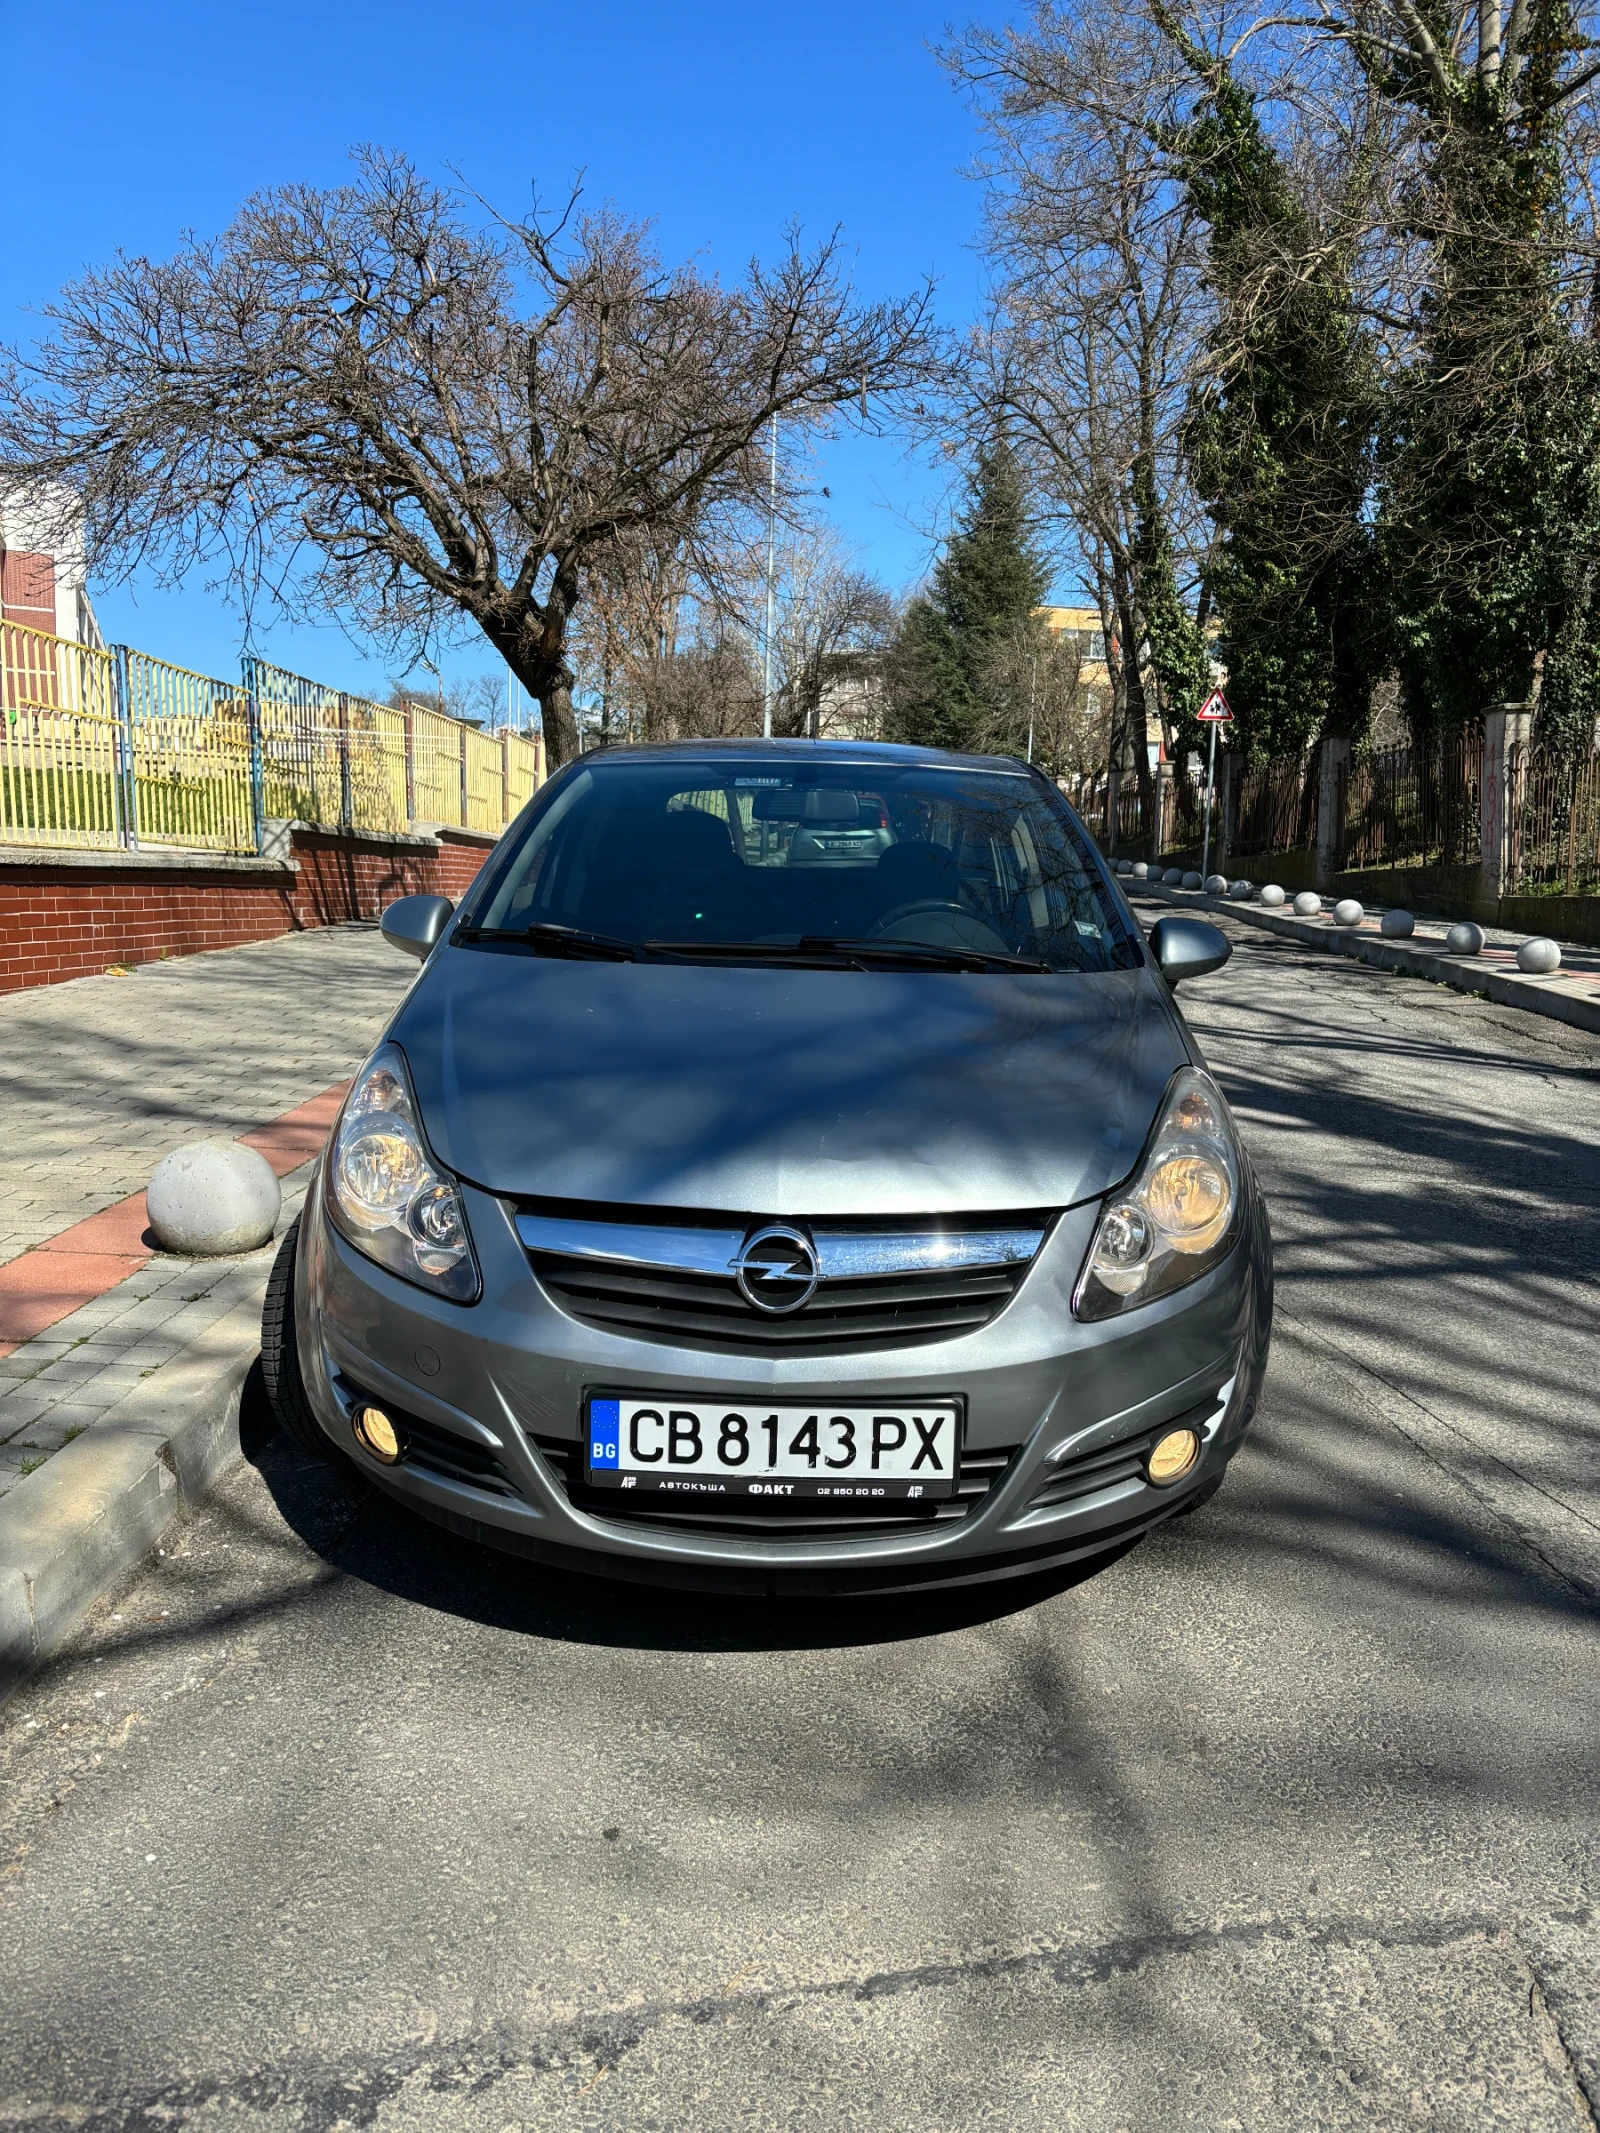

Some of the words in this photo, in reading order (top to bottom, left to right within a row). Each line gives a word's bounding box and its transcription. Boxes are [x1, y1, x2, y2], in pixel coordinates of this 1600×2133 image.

[630, 1409, 703, 1464] CB
[717, 1413, 857, 1469] 8143
[871, 1416, 946, 1470] PX
[593, 1443, 616, 1459] BG
[748, 1483, 795, 1495] ФАКТ
[817, 1487, 831, 1495] 02
[855, 1488, 869, 1496] 20
[871, 1488, 885, 1496] 20
